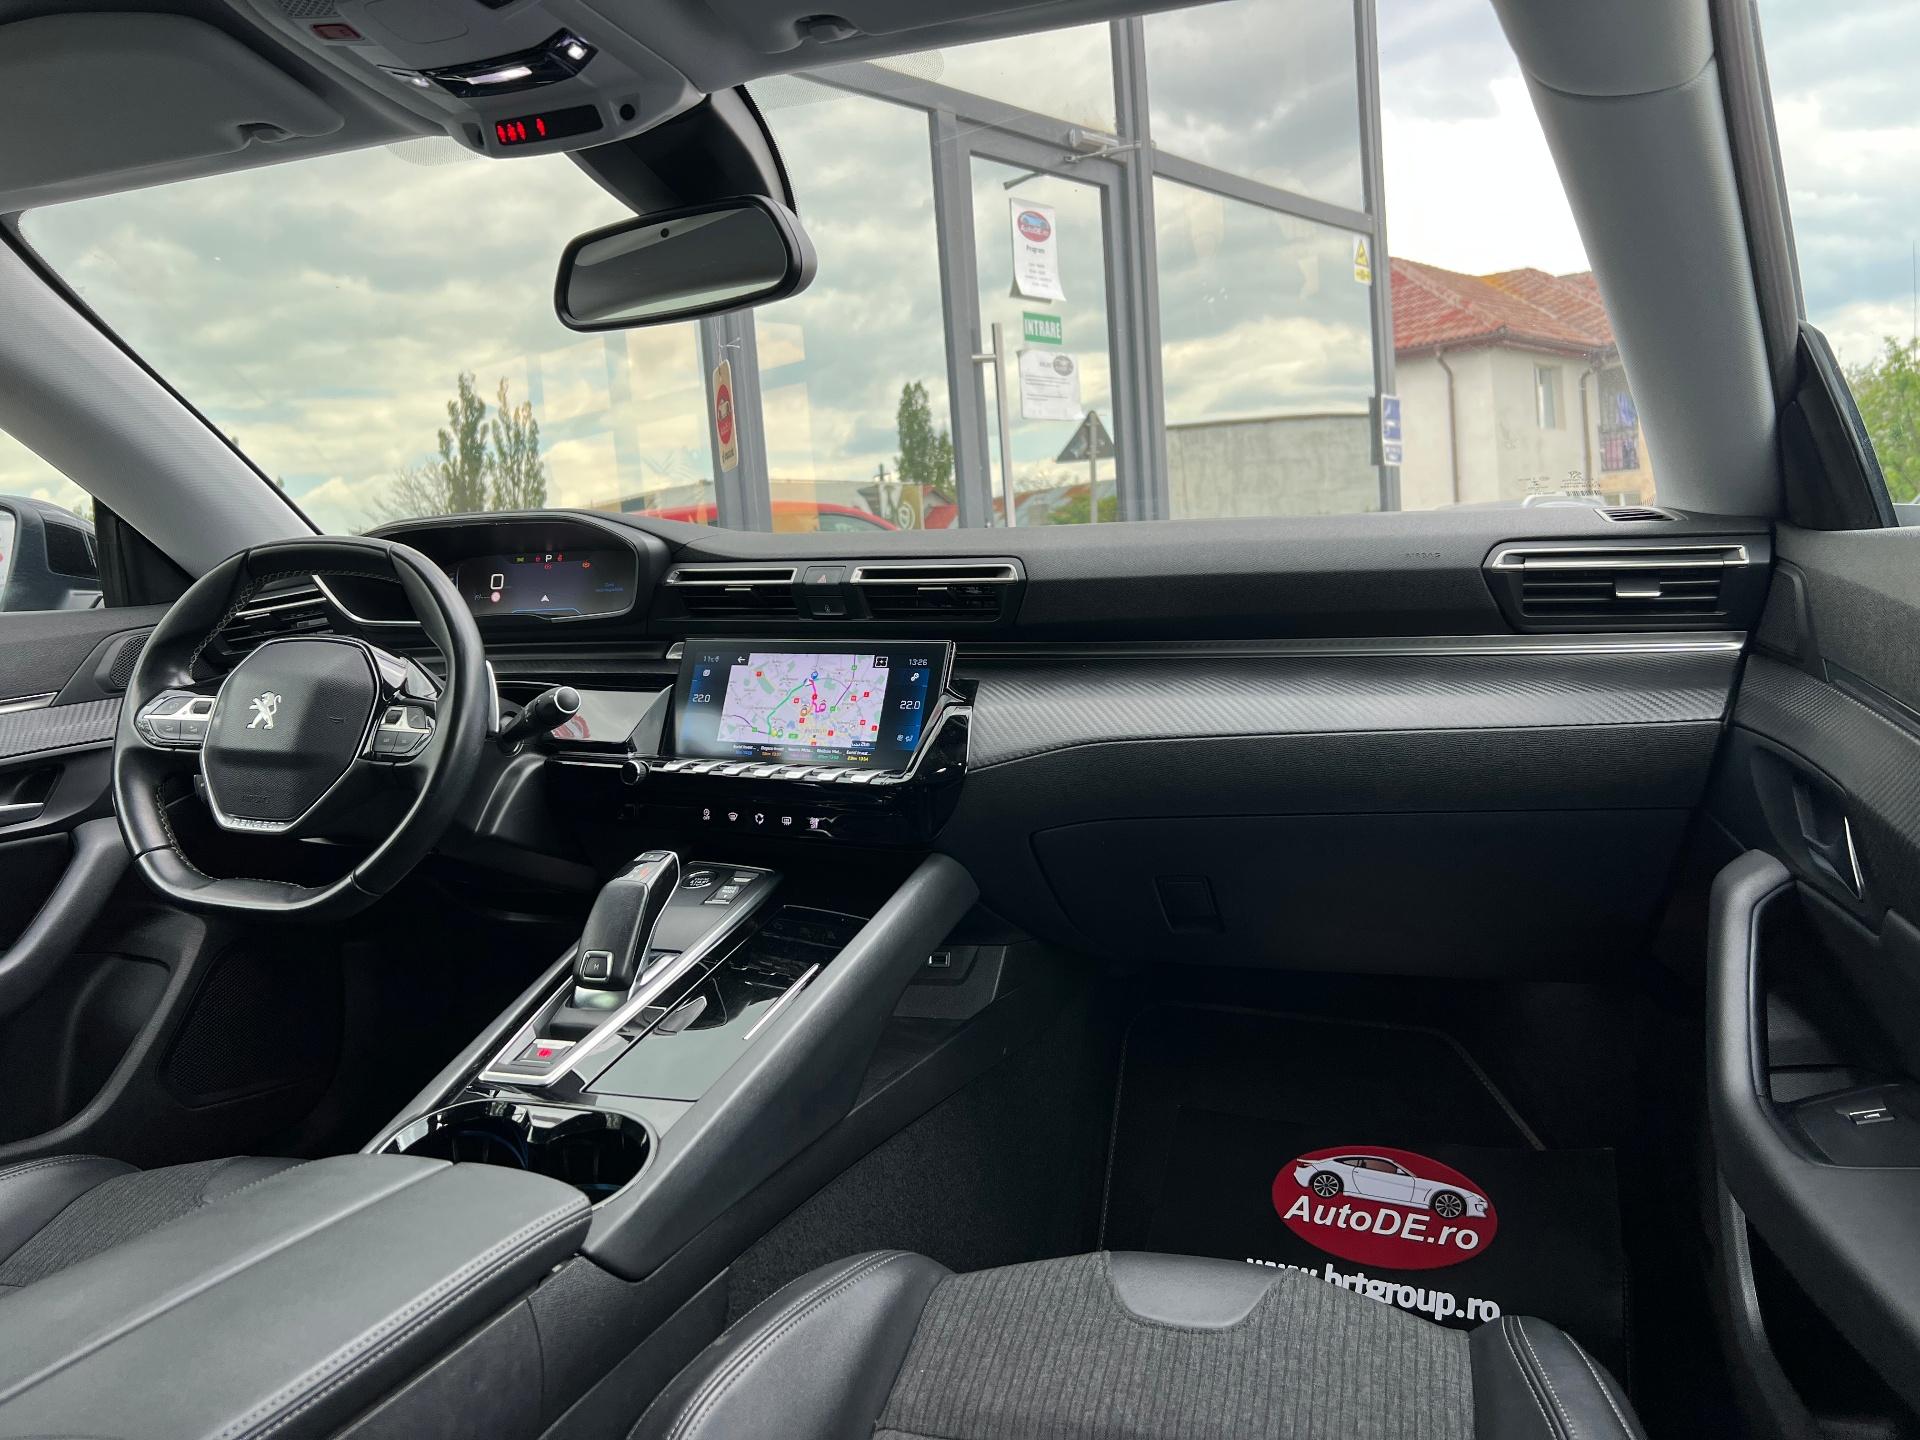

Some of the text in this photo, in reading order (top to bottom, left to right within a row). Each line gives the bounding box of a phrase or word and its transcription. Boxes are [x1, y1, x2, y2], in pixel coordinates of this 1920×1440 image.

[1024, 318, 1061, 338] INTRARE
[545, 554, 552, 563] P
[908, 658, 928, 666] 13:26
[692, 693, 711, 703] 22.0
[899, 700, 921, 710] 22.0
[231, 818, 285, 829] PEUGEOT
[1283, 1195, 1480, 1250] AutoDE.ro
[1246, 1258, 1500, 1322] hrtgroup.ro
